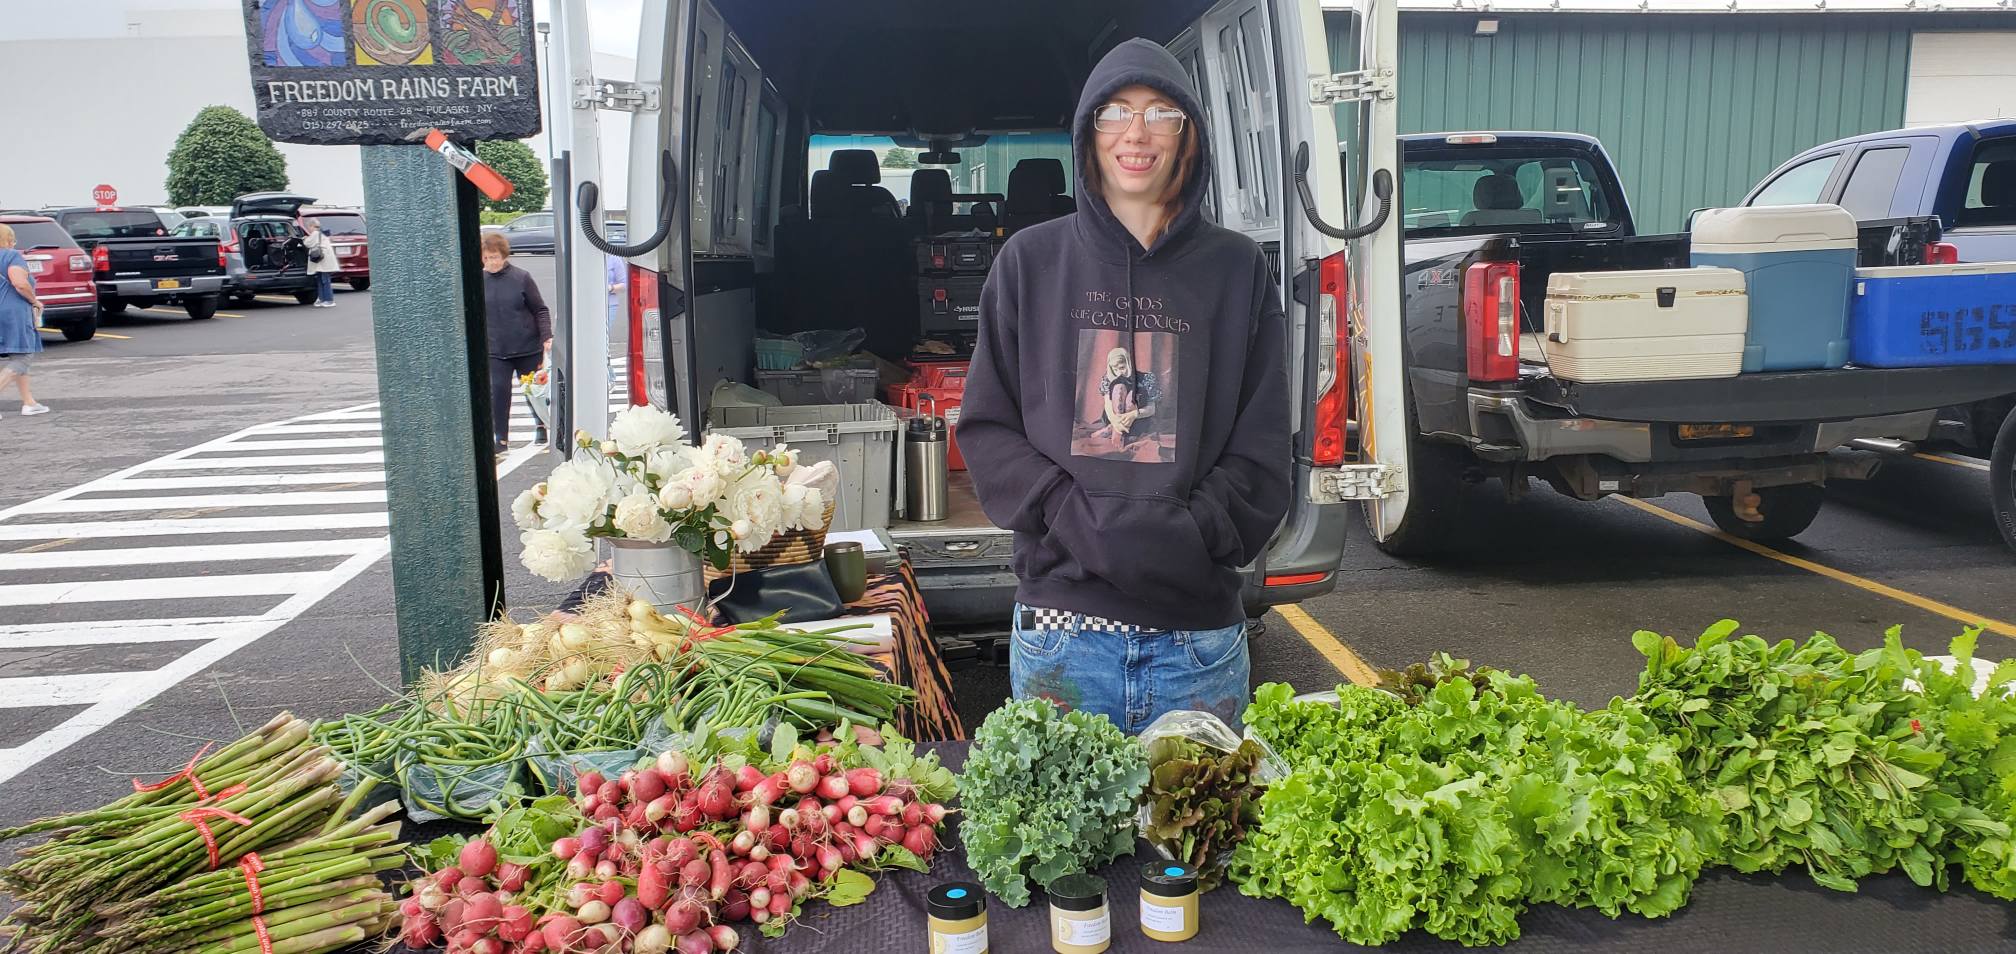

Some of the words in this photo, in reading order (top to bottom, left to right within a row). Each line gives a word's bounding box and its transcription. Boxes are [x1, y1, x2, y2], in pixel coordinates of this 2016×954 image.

[268, 79, 376, 103] FREEDOM
[381, 77, 450, 100] RAINS
[456, 76, 519, 98] FARM
[323, 108, 360, 116] COUNTY
[364, 108, 395, 116] ROUTE
[400, 107, 412, 115] 28
[426, 105, 470, 115] PULASKI
[95, 190, 116, 200] STOP
[1091, 311, 1129, 328] CAN
